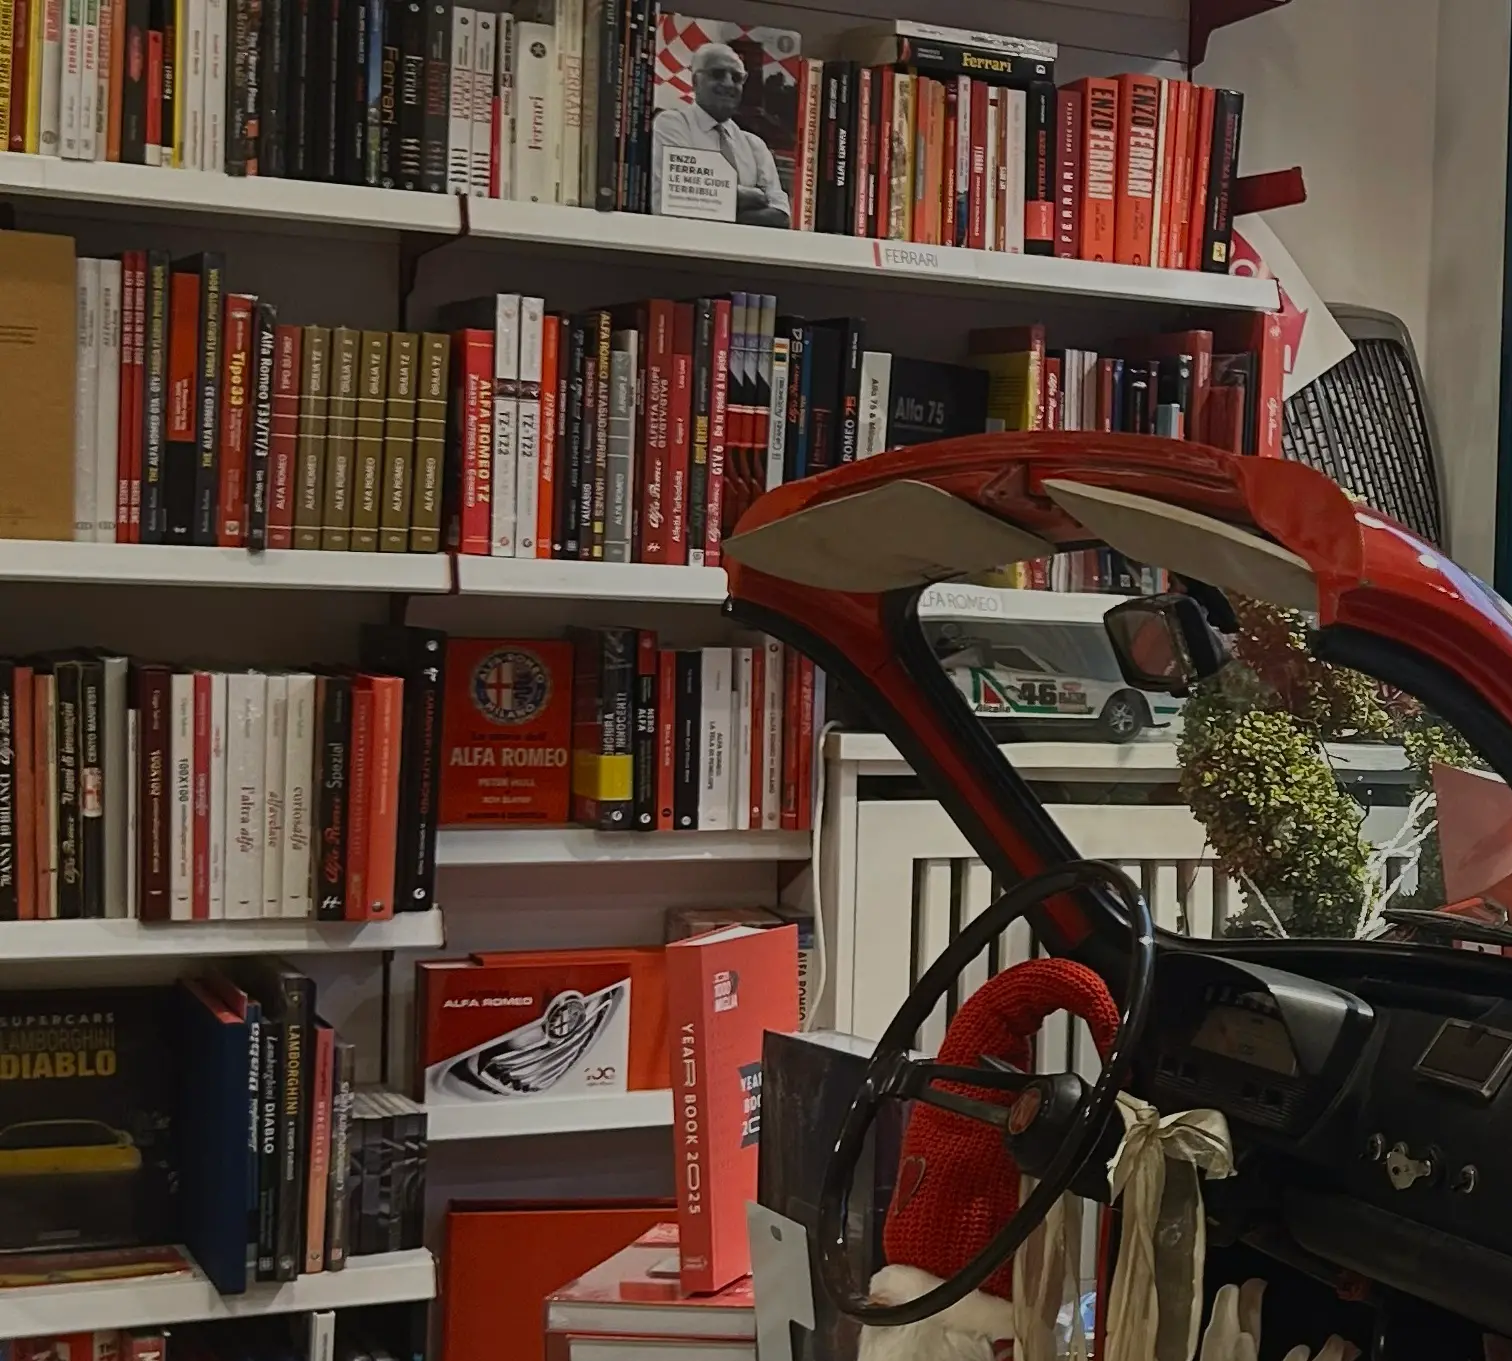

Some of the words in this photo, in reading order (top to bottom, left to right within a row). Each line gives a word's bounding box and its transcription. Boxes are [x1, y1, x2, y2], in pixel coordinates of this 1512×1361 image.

[961, 52, 1012, 73] Ferrari
[382, 45, 399, 124] Ferrari
[404, 55, 424, 105] Ferrari
[565, 54, 581, 128] FERRARI
[669, 154, 697, 164] ENZO
[669, 164, 714, 176] FERRARI
[885, 248, 938, 268] FERRARI
[599, 311, 611, 339] ALFA
[259, 330, 273, 356] Alfa
[229, 351, 246, 384] Tipo
[257, 358, 272, 400] Romeo
[230, 385, 245, 405] 33
[479, 380, 490, 419] ALFA
[895, 396, 924, 422] Alfa
[927, 400, 944, 425] 75
[255, 403, 271, 457] T33/TT/3
[649, 404, 660, 448] ALFETTA
[478, 423, 490, 479] ROMEO
[843, 419, 855, 462] ROMEO
[276, 487, 286, 510] ALFA
[306, 487, 315, 510] ALFA
[335, 489, 345, 510] ALFA
[364, 489, 374, 511] ALFA
[393, 489, 402, 511] ALFA
[425, 490, 434, 511] ALFA
[478, 485, 489, 503] TZ
[947, 593, 997, 612] ROMEO
[1020, 682, 1057, 705] 46
[484, 701, 536, 718] MILANO
[325, 742, 344, 788] Spezial
[450, 747, 496, 767] ALFA
[501, 748, 567, 768] ROMEO
[241, 786, 256, 823] l'altra
[290, 786, 308, 850] curiosalfa
[324, 796, 341, 844] Romeo
[236, 827, 254, 853] alfa
[63, 857, 80, 884] Alfa
[324, 851, 343, 883] Alfa
[443, 997, 479, 1008] ALFA
[481, 996, 533, 1007] ROMEO
[0, 1026, 115, 1051] LAMBORGHINI
[0, 1049, 117, 1080] DIABLO
[681, 1023, 697, 1087] YEAR
[286, 1024, 300, 1115] LAMBORGHINI
[264, 1102, 276, 1154] DIABLO
[685, 1094, 699, 1145] BOOK
[687, 1151, 701, 1214] 2025
